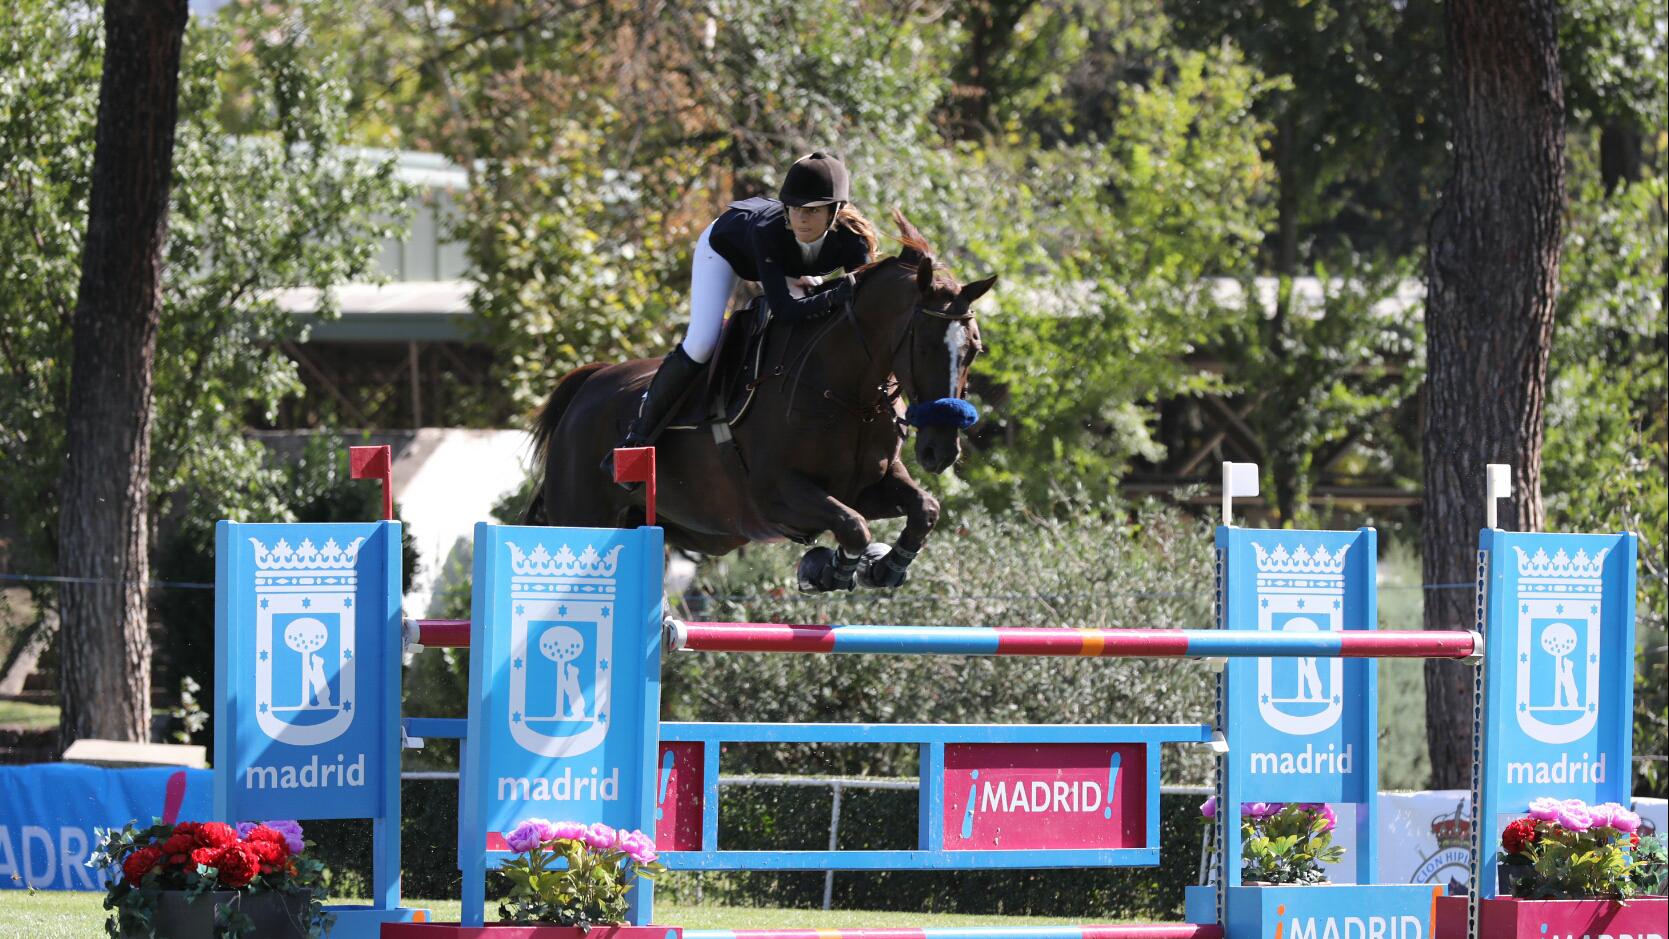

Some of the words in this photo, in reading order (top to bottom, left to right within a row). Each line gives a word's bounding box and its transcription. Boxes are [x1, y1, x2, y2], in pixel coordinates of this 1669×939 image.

[245, 753, 366, 790] madrid
[1250, 744, 1352, 774] madrid
[1507, 752, 1606, 785] madrid
[496, 767, 620, 801] madrid
